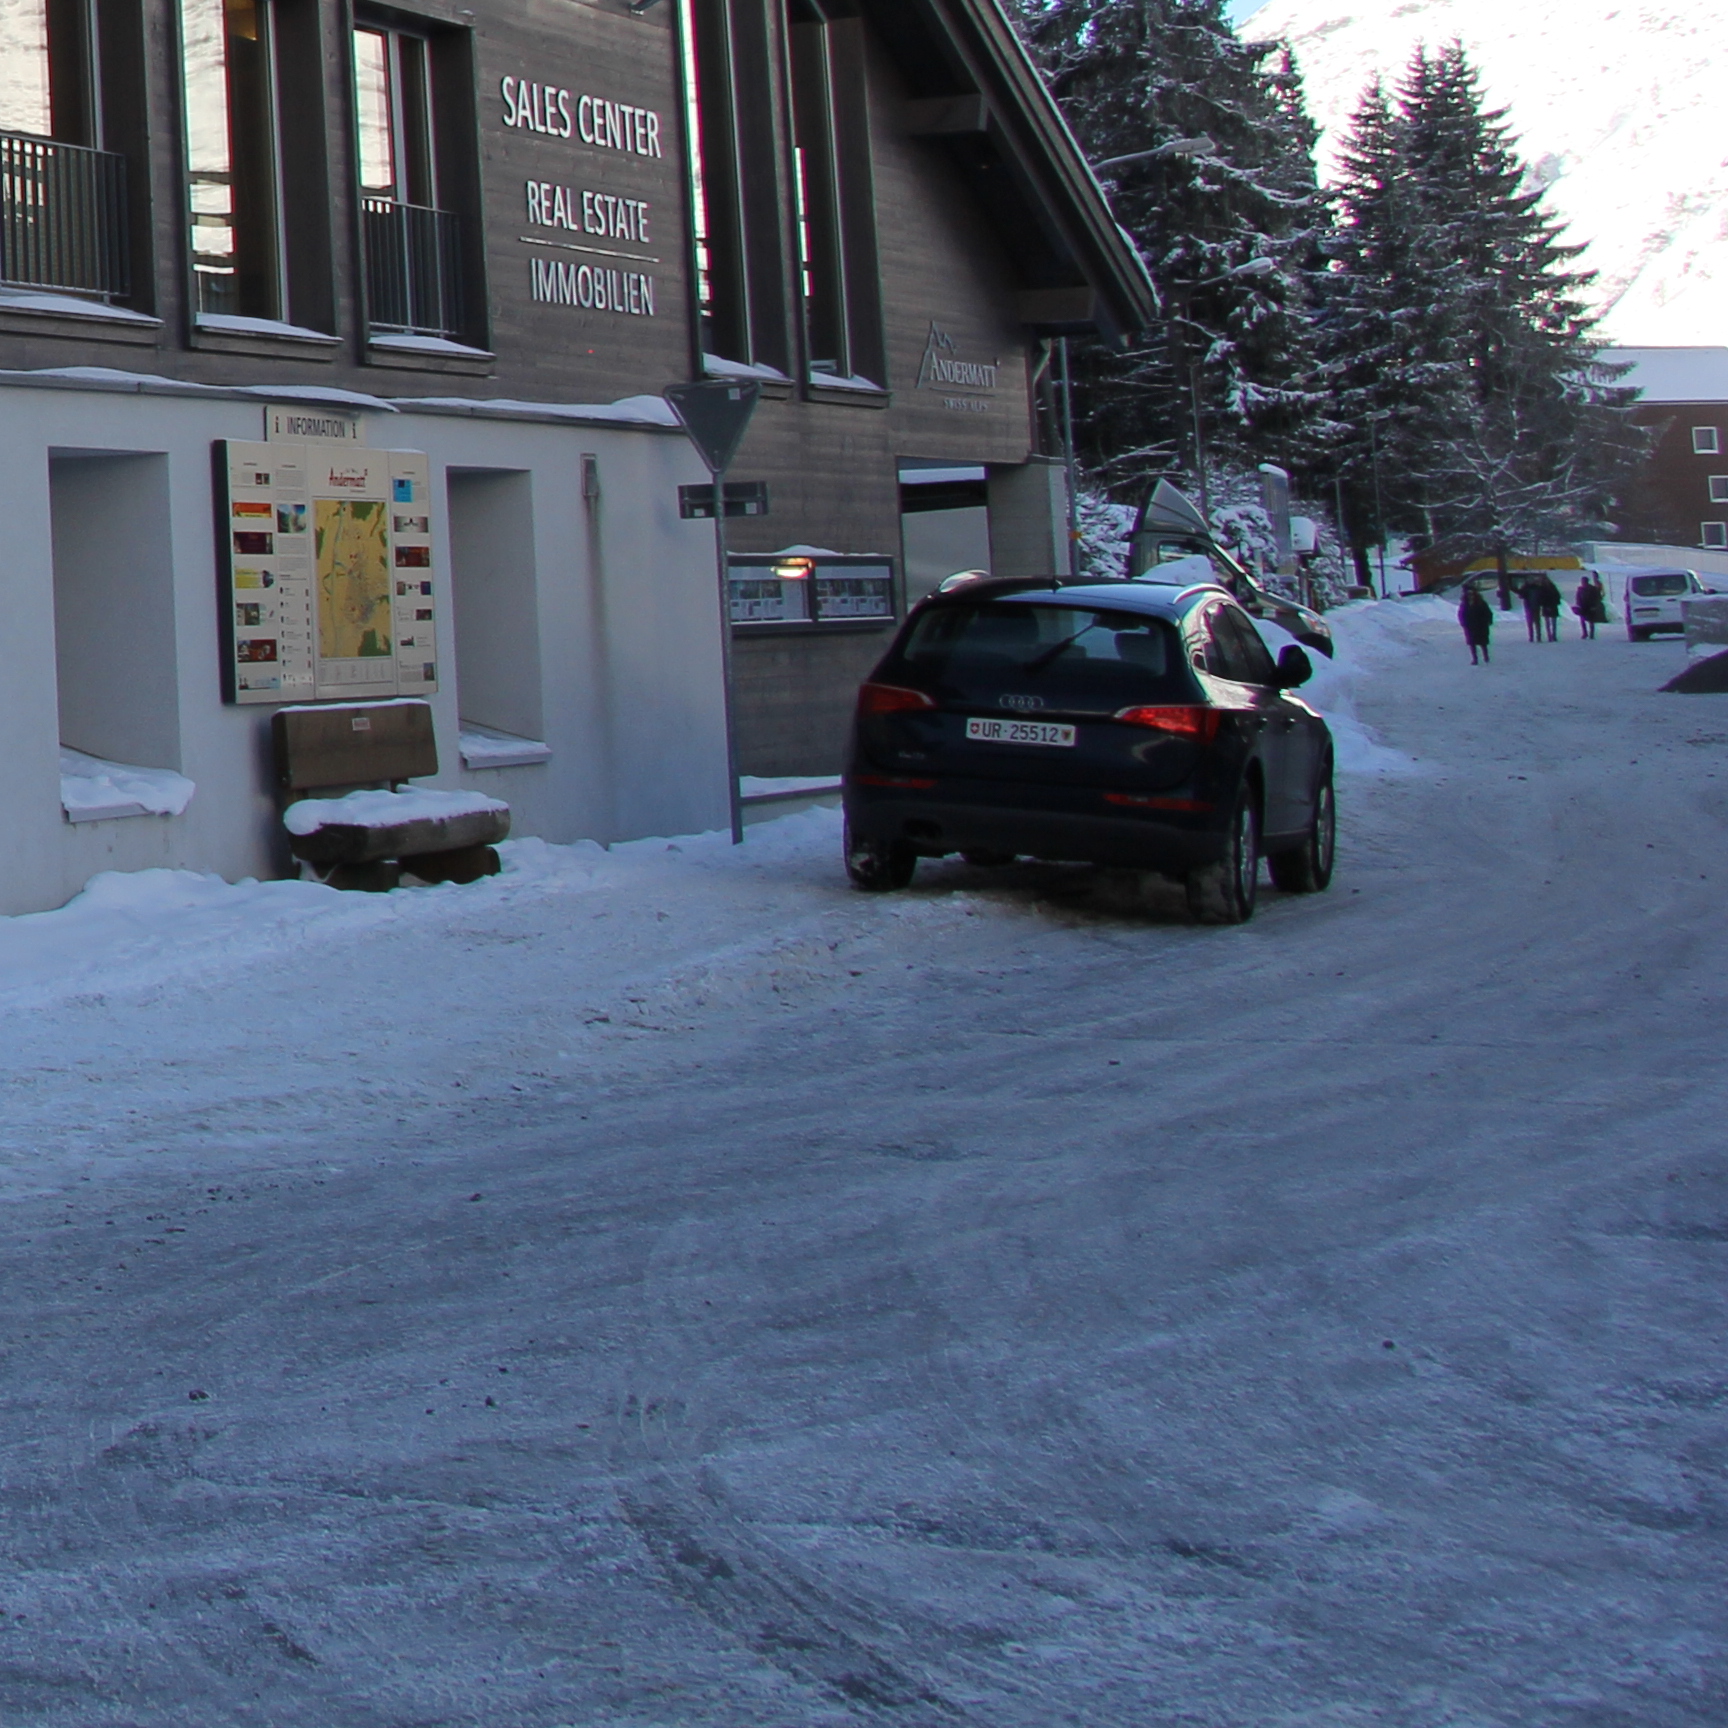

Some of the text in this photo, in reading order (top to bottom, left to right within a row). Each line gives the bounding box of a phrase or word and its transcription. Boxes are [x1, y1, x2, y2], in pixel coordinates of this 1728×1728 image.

[501, 76, 662, 158] SALES CENTER
[525, 179, 650, 243] REAL ESTATE
[530, 258, 654, 317] IMMOBILIEN
[929, 351, 997, 388] ANDERMATT
[287, 416, 346, 438] INFORMATION
[329, 467, 366, 488] Andermatt
